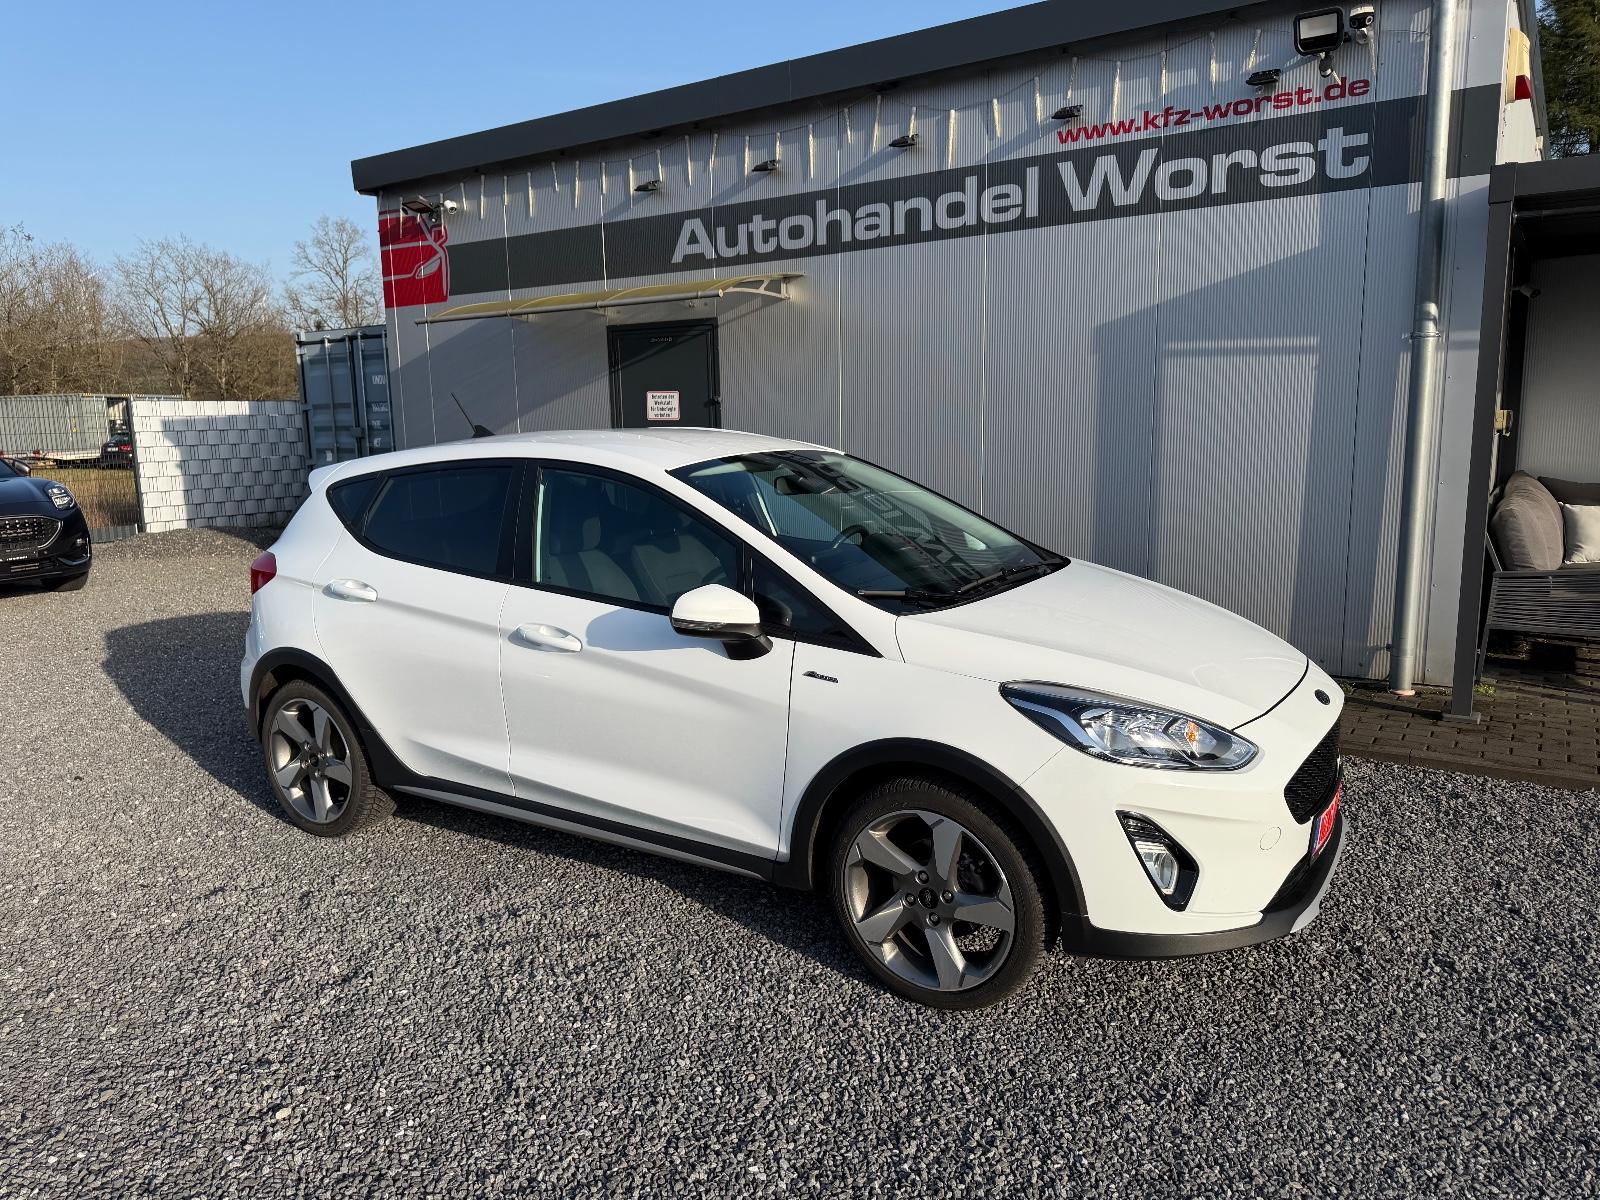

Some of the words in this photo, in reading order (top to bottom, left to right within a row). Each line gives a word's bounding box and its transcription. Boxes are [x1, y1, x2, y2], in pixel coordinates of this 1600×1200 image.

[1056, 76, 1370, 145] www.kfz-worst.de
[670, 165, 1040, 264] Autohandel
[1056, 125, 1370, 212] Worst
